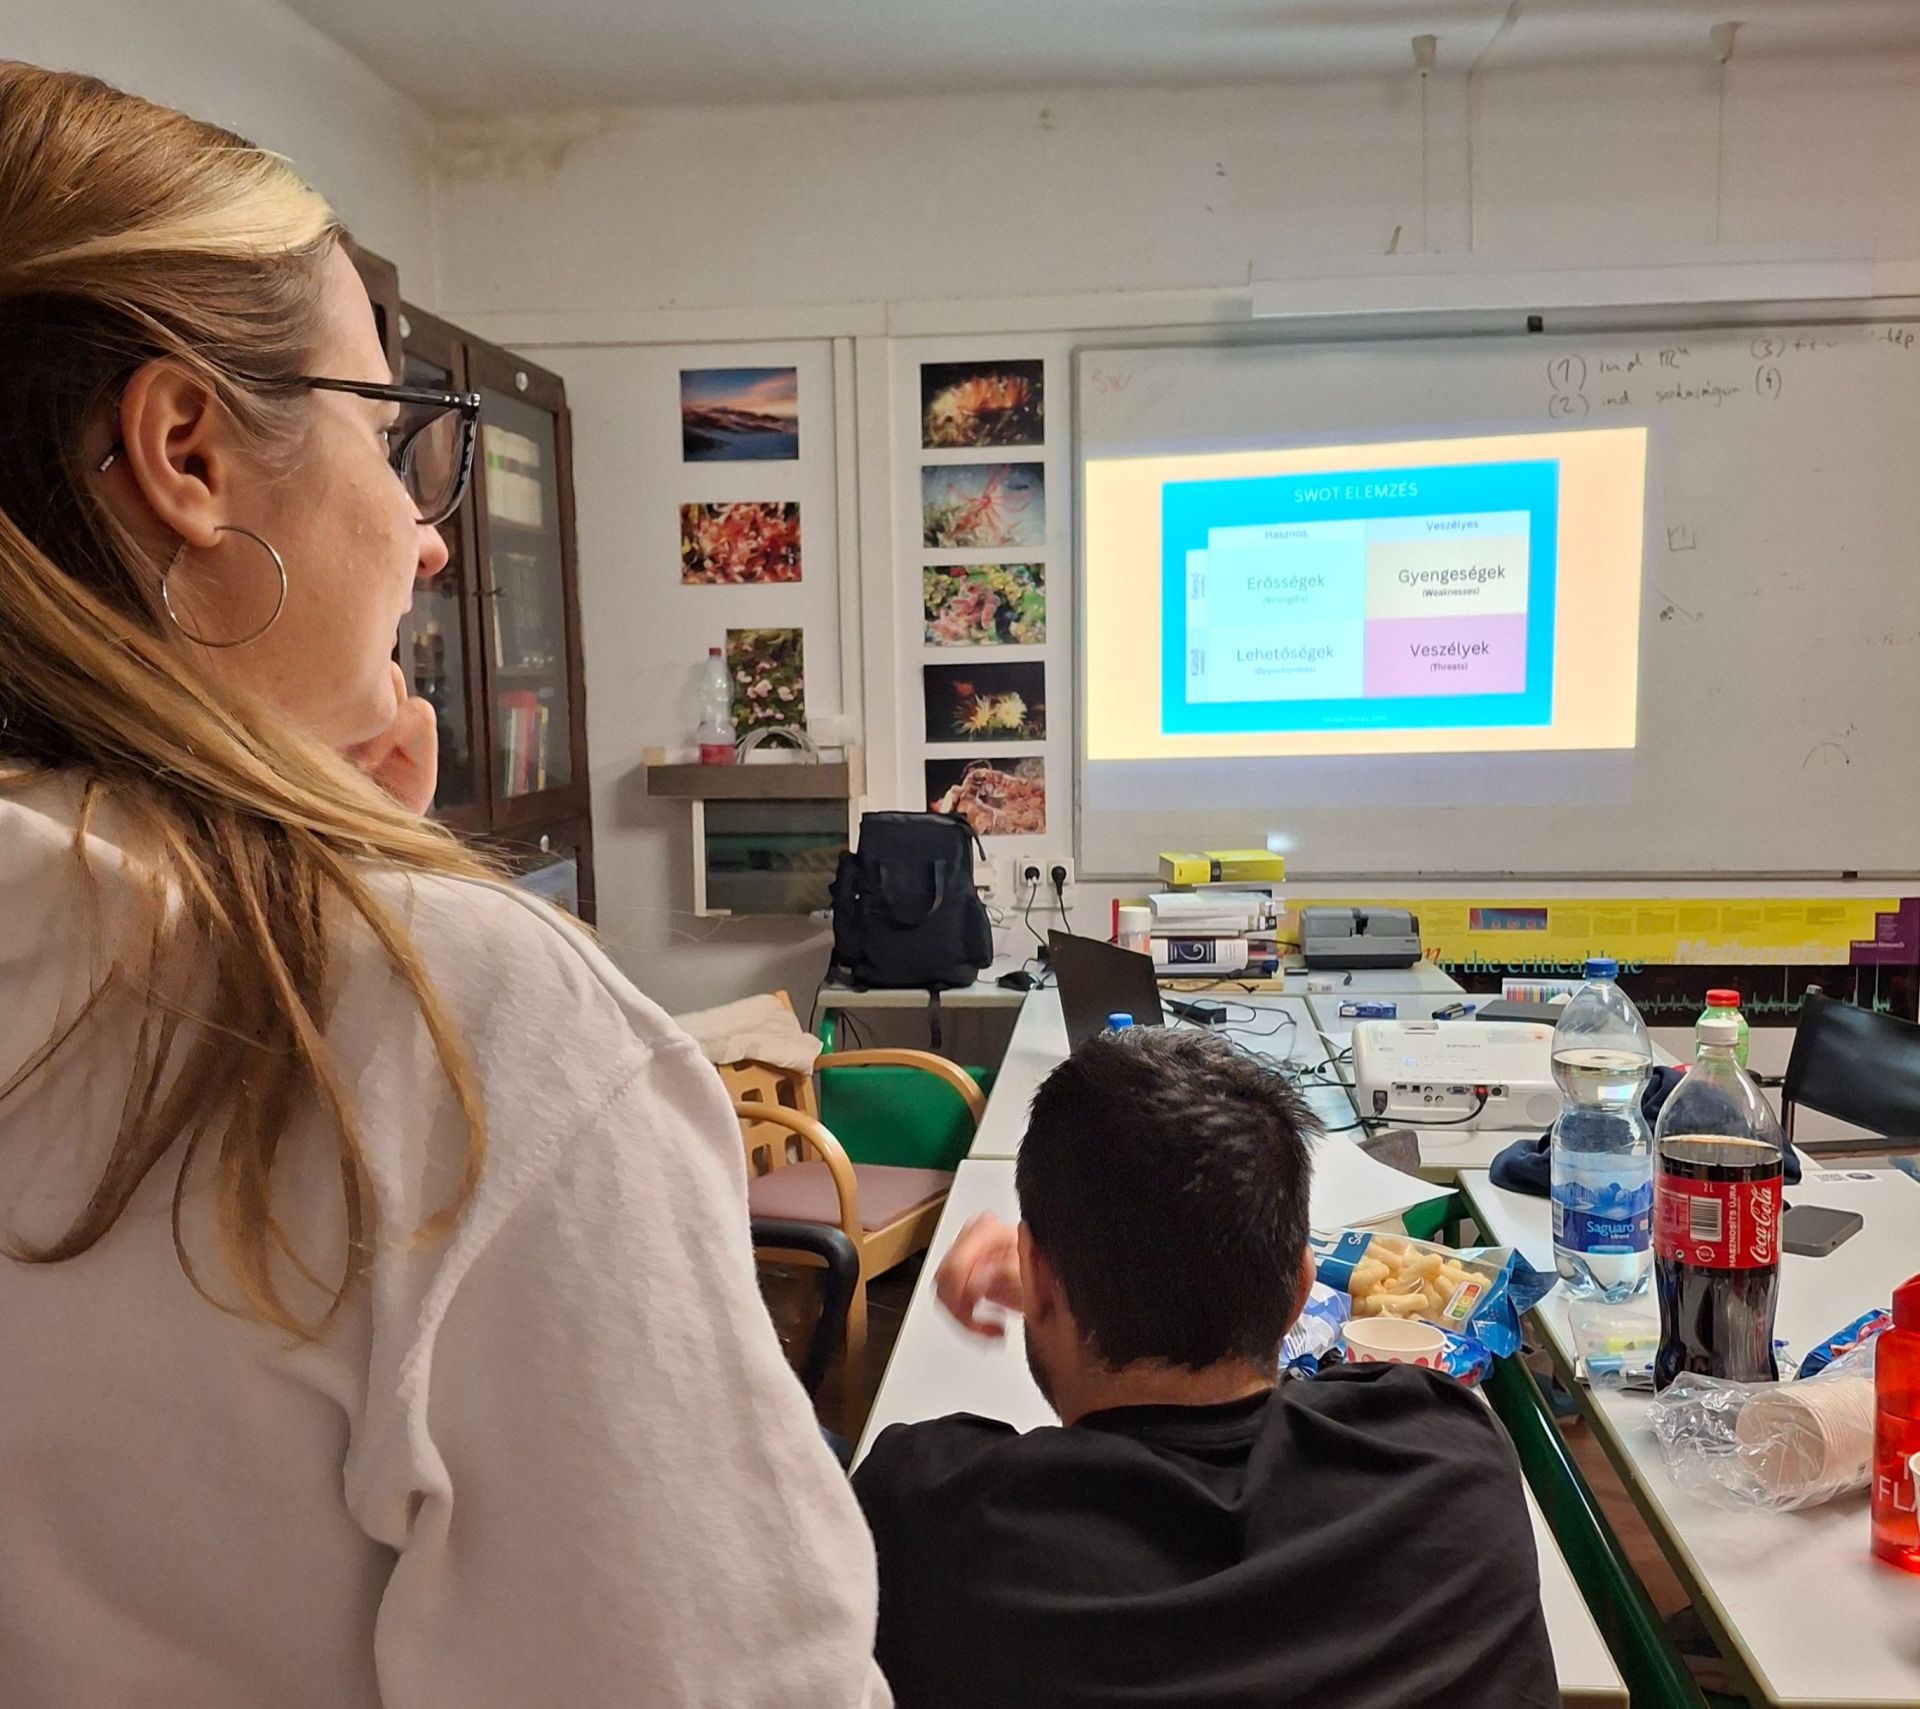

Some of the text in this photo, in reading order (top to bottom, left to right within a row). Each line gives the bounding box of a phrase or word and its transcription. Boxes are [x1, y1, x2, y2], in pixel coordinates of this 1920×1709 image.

[1294, 481, 1418, 503] SWOT ELEMZÉS
[1264, 529, 1308, 540] Hasznos
[1425, 519, 1480, 532] Veszélyes
[1247, 573, 1325, 591] Erősségek
[1398, 564, 1506, 586] Gyengeségek
[1422, 587, 1480, 597] (Weaknesses)
[1236, 645, 1334, 662] Lehetőségek
[1410, 640, 1490, 659] Veszélyek
[1430, 662, 1468, 672] (Threats)
[1463, 948, 1501, 974] the
[1586, 1221, 1635, 1237] Saguaro
[1750, 1184, 1772, 1264] Coca-Cola
[1728, 1209, 1737, 1267] HASZNOSÍTS
